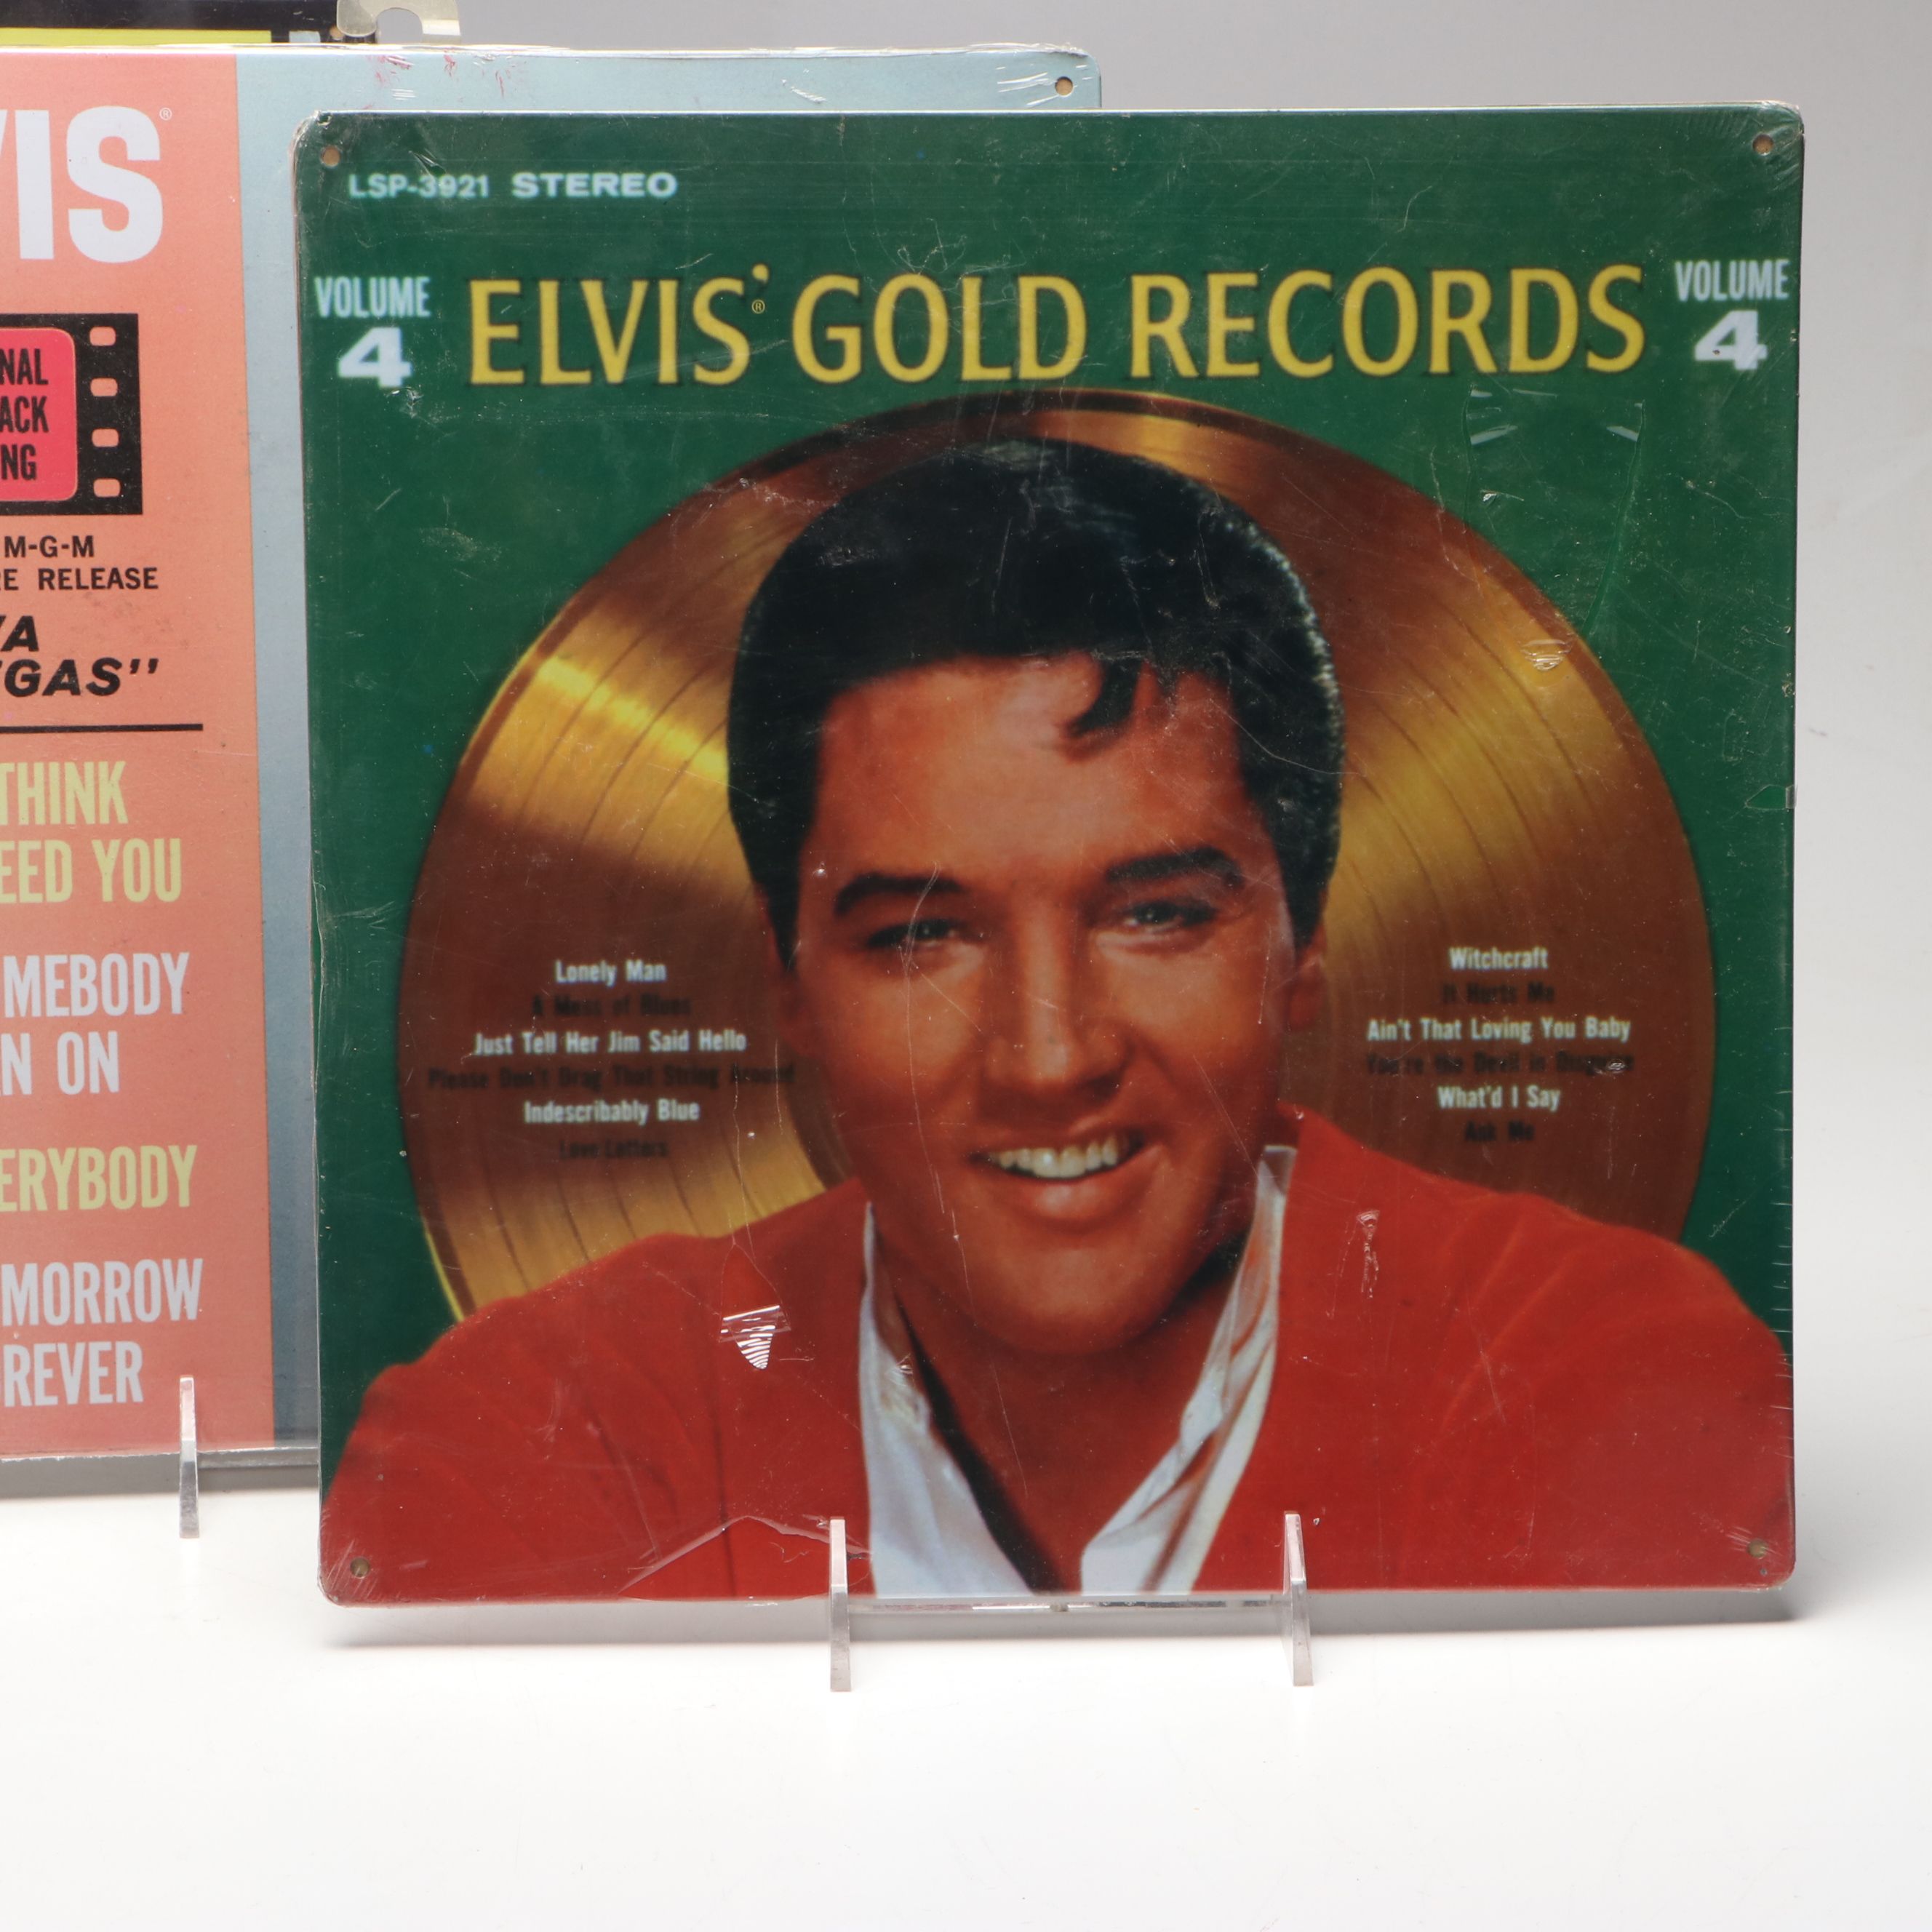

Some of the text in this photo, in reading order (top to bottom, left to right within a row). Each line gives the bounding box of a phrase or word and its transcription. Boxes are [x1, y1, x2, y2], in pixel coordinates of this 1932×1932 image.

[349, 171, 678, 199] LSP-3921 STEREO
[314, 275, 431, 319] VOLUME
[1674, 258, 1790, 303] VOLUME
[791, 273, 1087, 385] GOLD
[1130, 264, 1646, 378] RECORDS
[1694, 309, 1768, 371] 4
[337, 326, 412, 388] 4
[4, 535, 95, 559] M-G-M
[38, 567, 159, 591] RELEASE
[0, 760, 129, 826] THINK
[92, 837, 182, 903] YOU
[555, 959, 668, 987] Lonely Man
[1448, 946, 1549, 971] Witchcraft
[3, 951, 190, 1018] MEBODY
[473, 1029, 747, 1056] Just Tell Her Jim Said Hello
[1366, 1015, 1632, 1044] Ain't That Loving You Baby
[57, 1030, 120, 1095] ON
[523, 1098, 700, 1127] Indescribably Blue
[1437, 1085, 1562, 1113] What'd I Say
[1, 1258, 204, 1328] MORROW
[3, 1340, 144, 1408] REVER
